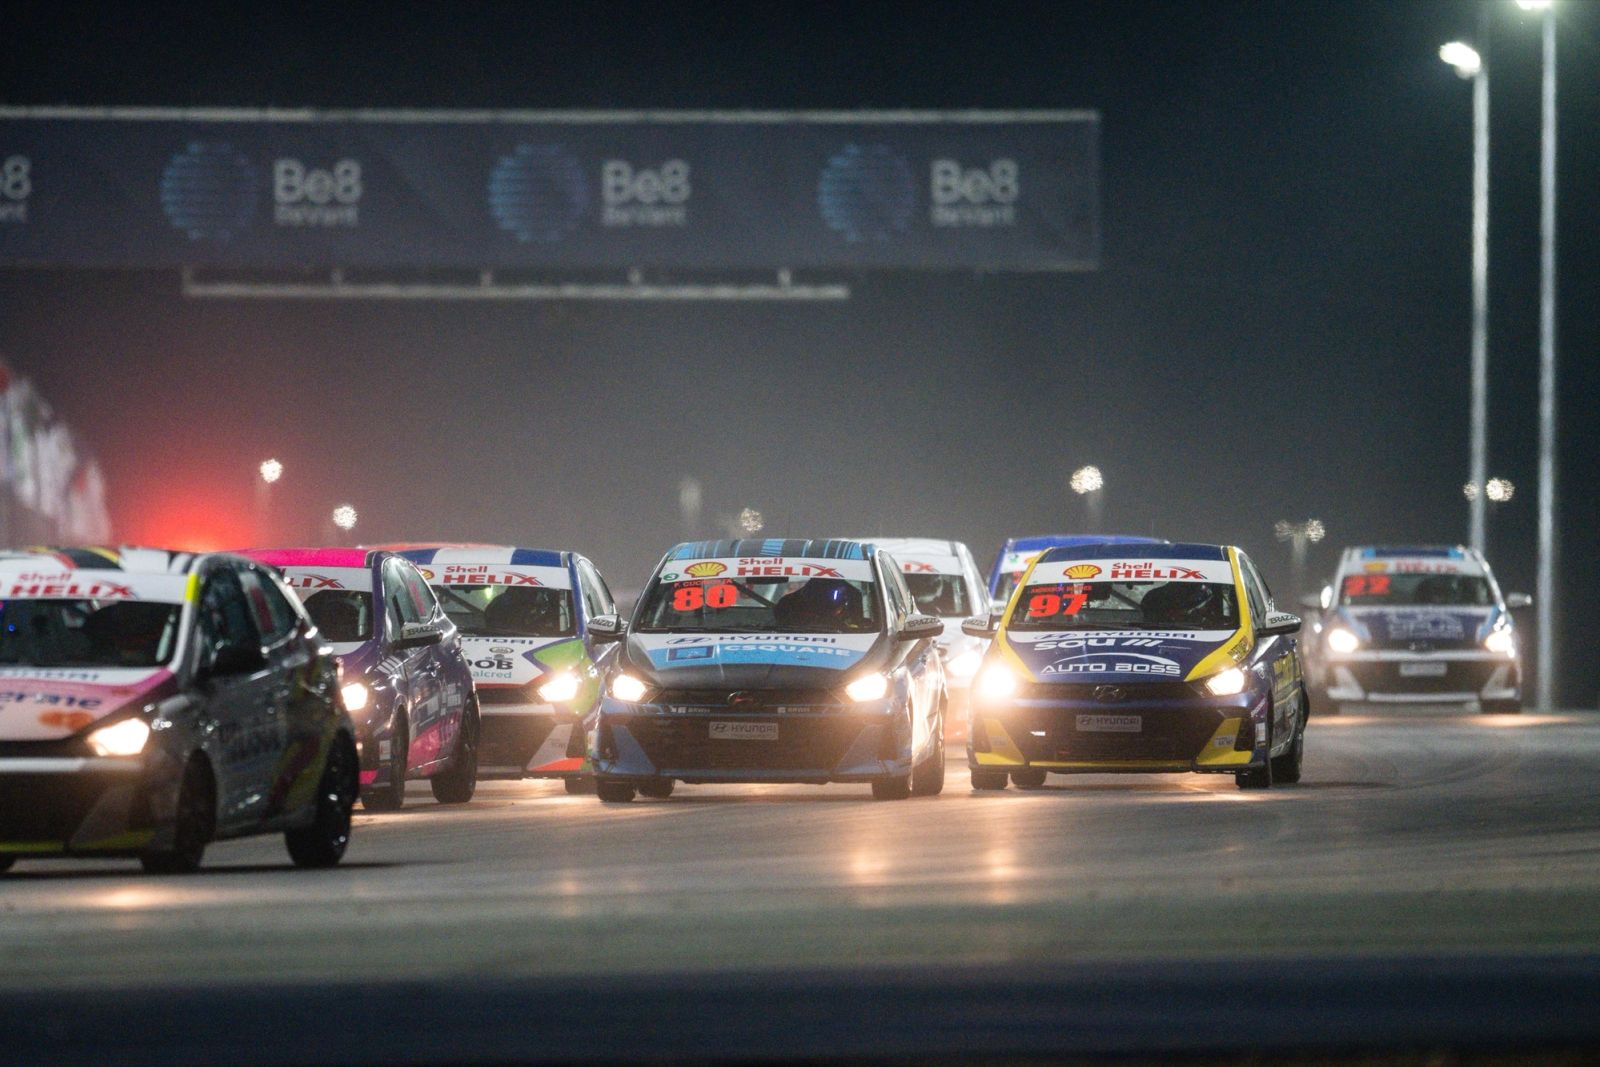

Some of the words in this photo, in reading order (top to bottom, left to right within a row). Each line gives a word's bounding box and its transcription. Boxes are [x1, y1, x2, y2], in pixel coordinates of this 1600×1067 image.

[274, 158, 363, 204] Be8
[602, 158, 691, 204] Be8
[931, 158, 1019, 204] Be8
[737, 566, 839, 578] HELIX
[1111, 562, 1152, 570] Shell
[443, 574, 541, 586] HELIX
[1110, 569, 1204, 580] HELIX
[283, 576, 341, 589] LIX
[9, 583, 134, 598] HELIX
[672, 586, 738, 612] 80
[1028, 593, 1088, 618] 97
[718, 635, 837, 644] HYUNDAI
[724, 645, 851, 657] CSQUARE
[1040, 663, 1107, 674] AUTO
[1114, 662, 1181, 675] BOSS
[1096, 717, 1140, 726] HYUNDAI
[730, 724, 777, 734] HYUNDAI
